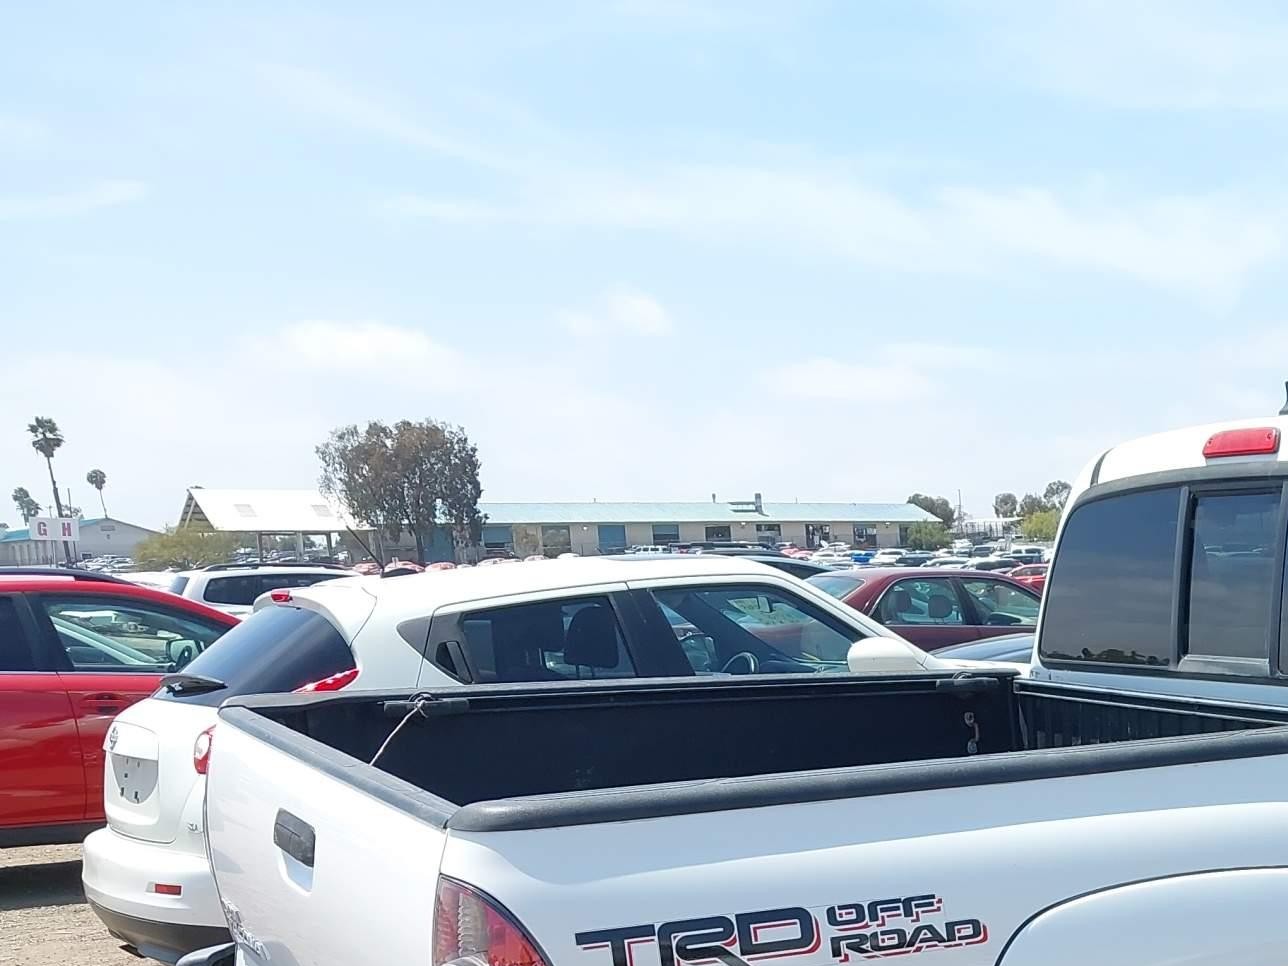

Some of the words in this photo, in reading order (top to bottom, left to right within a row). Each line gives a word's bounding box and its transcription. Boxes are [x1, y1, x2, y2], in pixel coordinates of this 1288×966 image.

[37, 521, 48, 537] G
[61, 522, 72, 537] H
[826, 893, 942, 931] OFF
[829, 918, 989, 963] ROAD
